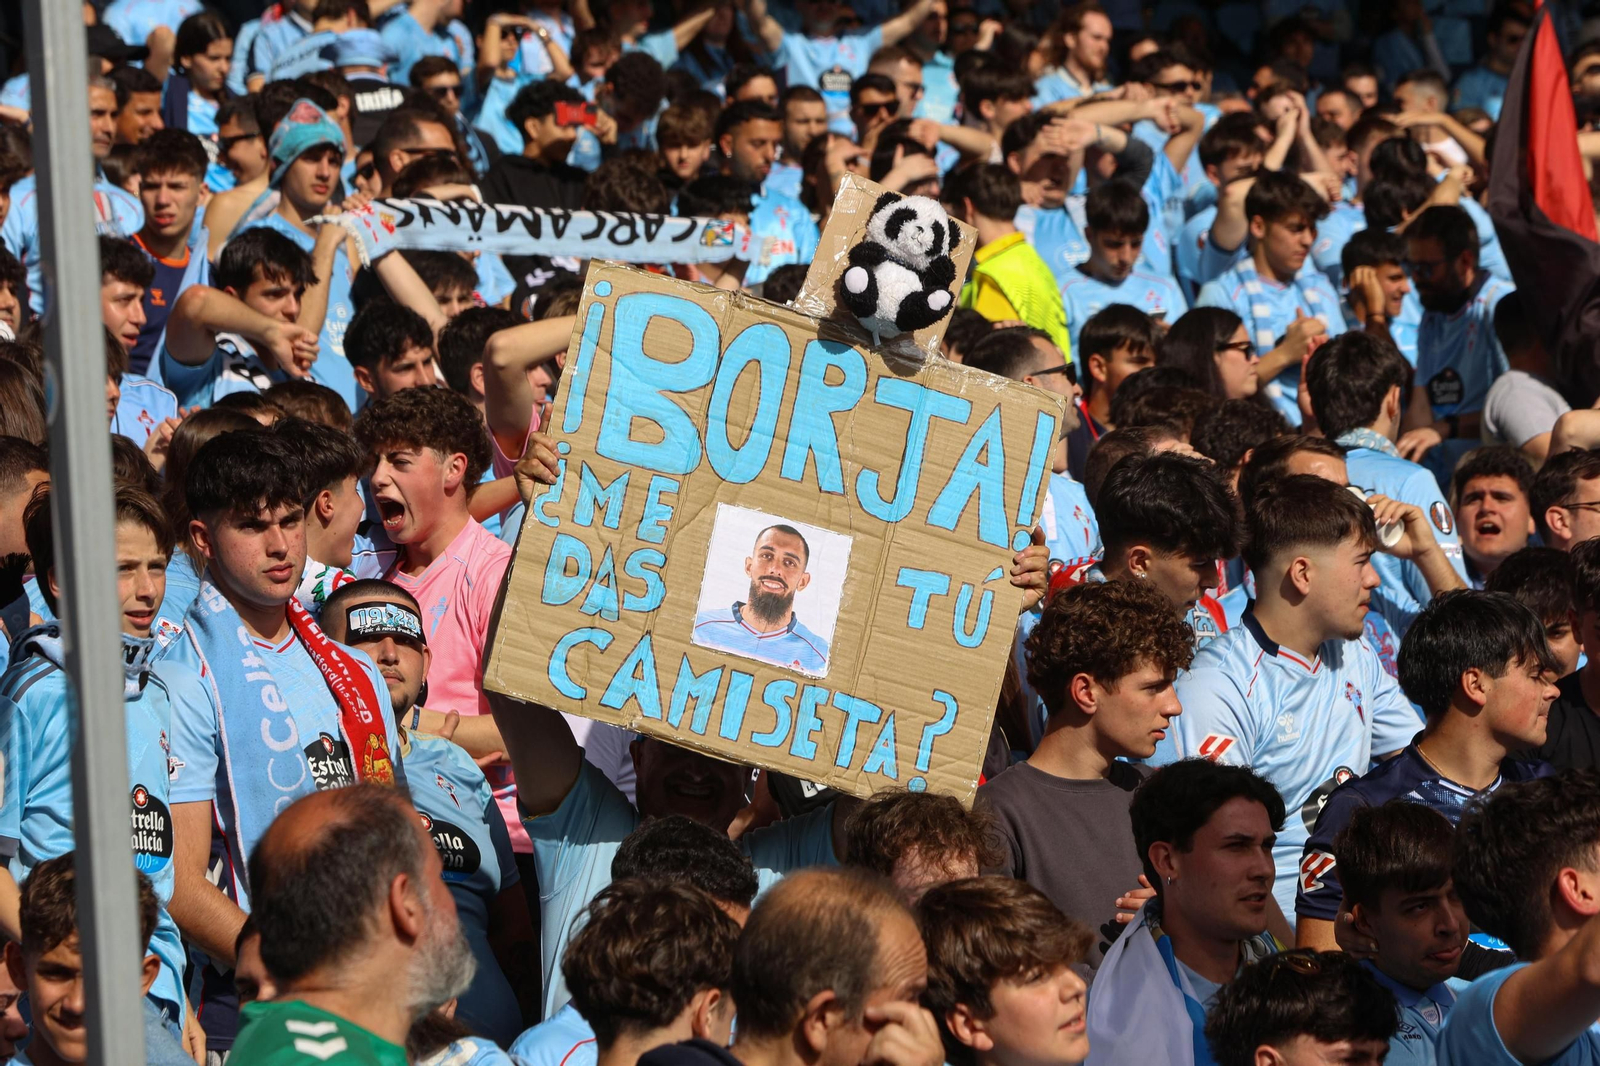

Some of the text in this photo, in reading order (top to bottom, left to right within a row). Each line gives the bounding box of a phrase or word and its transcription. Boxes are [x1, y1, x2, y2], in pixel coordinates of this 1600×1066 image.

[562, 279, 1056, 552] ¡BORJA!
[533, 441, 681, 544] ¿ME
[540, 531, 668, 623] DAS
[895, 565, 1005, 649] TÚ
[547, 626, 960, 793] CAMISETA?
[130, 808, 165, 832] trella
[131, 830, 163, 853] alicia
